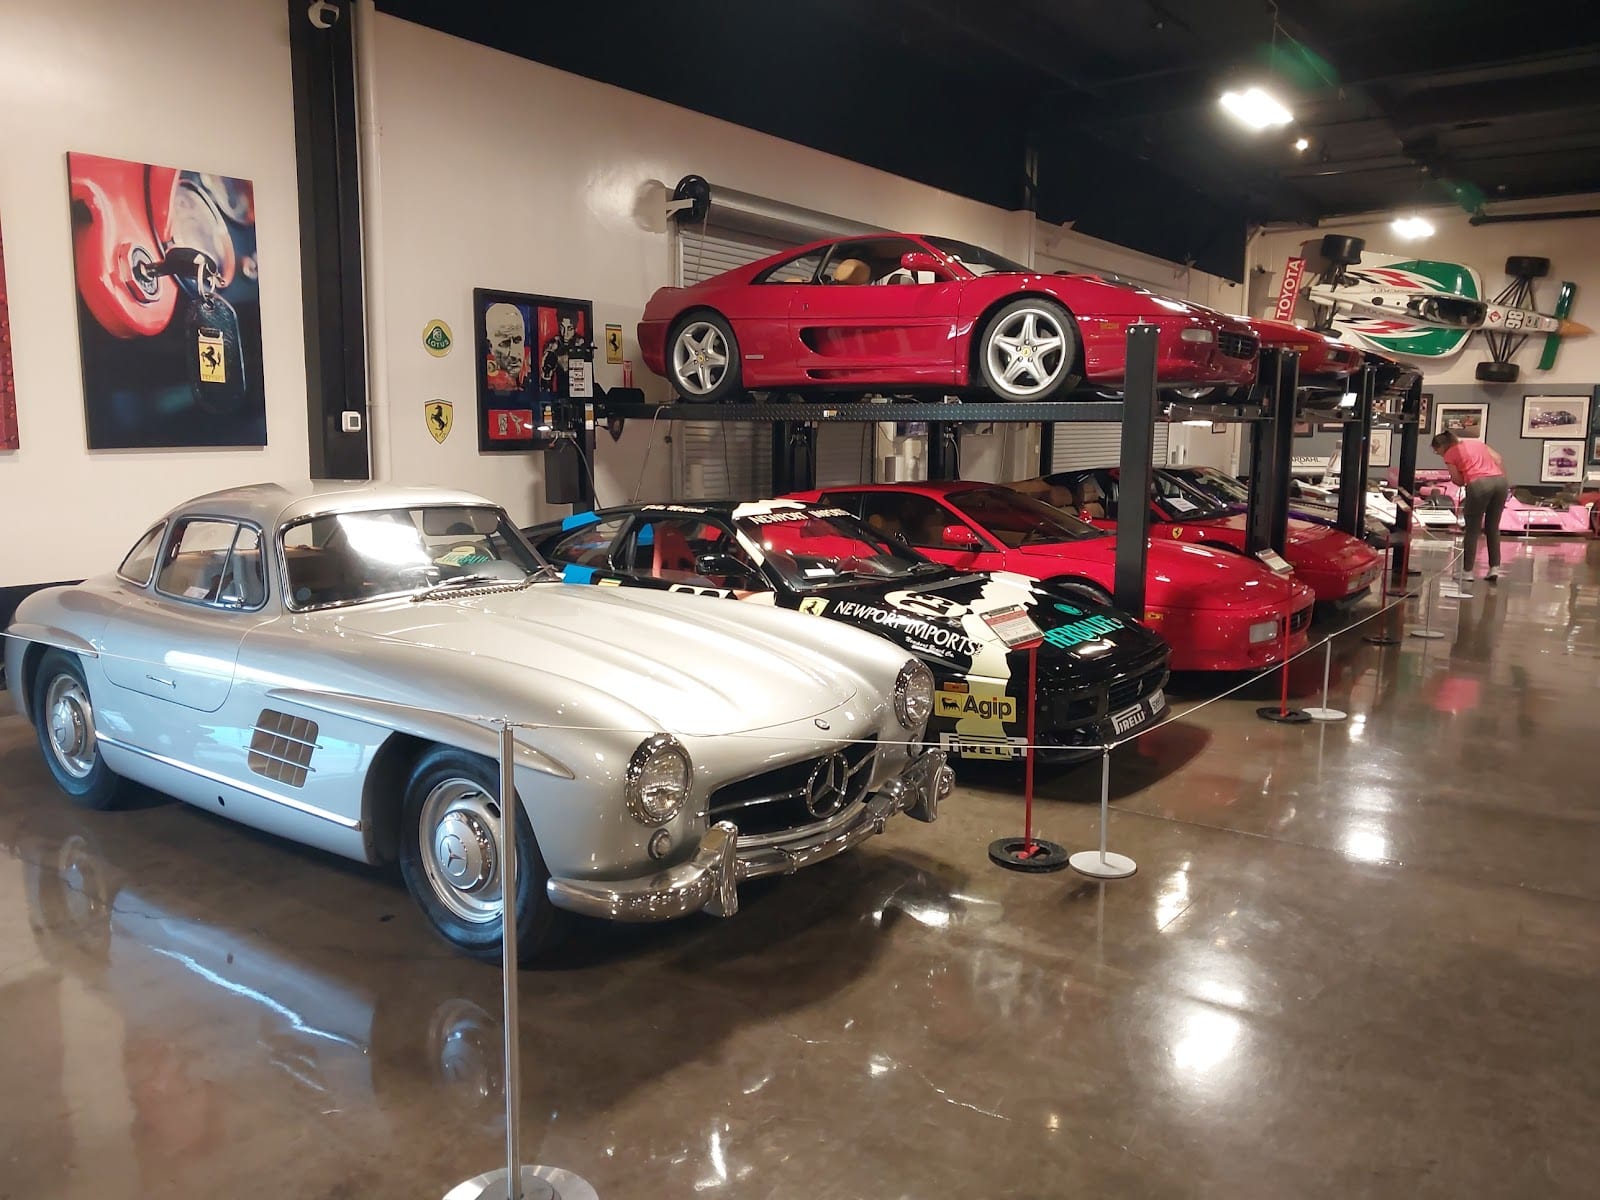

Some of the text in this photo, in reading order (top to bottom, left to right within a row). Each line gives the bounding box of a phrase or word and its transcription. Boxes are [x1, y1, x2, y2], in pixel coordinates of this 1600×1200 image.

[1276, 260, 1301, 319] TOYOTA
[426, 339, 450, 349] LOTUS
[747, 512, 809, 525] NEWPORT
[833, 600, 904, 629] NEWPORT
[903, 617, 977, 656] IMPORTS
[962, 694, 1013, 720] Agip
[1110, 703, 1146, 736] PIRELLI
